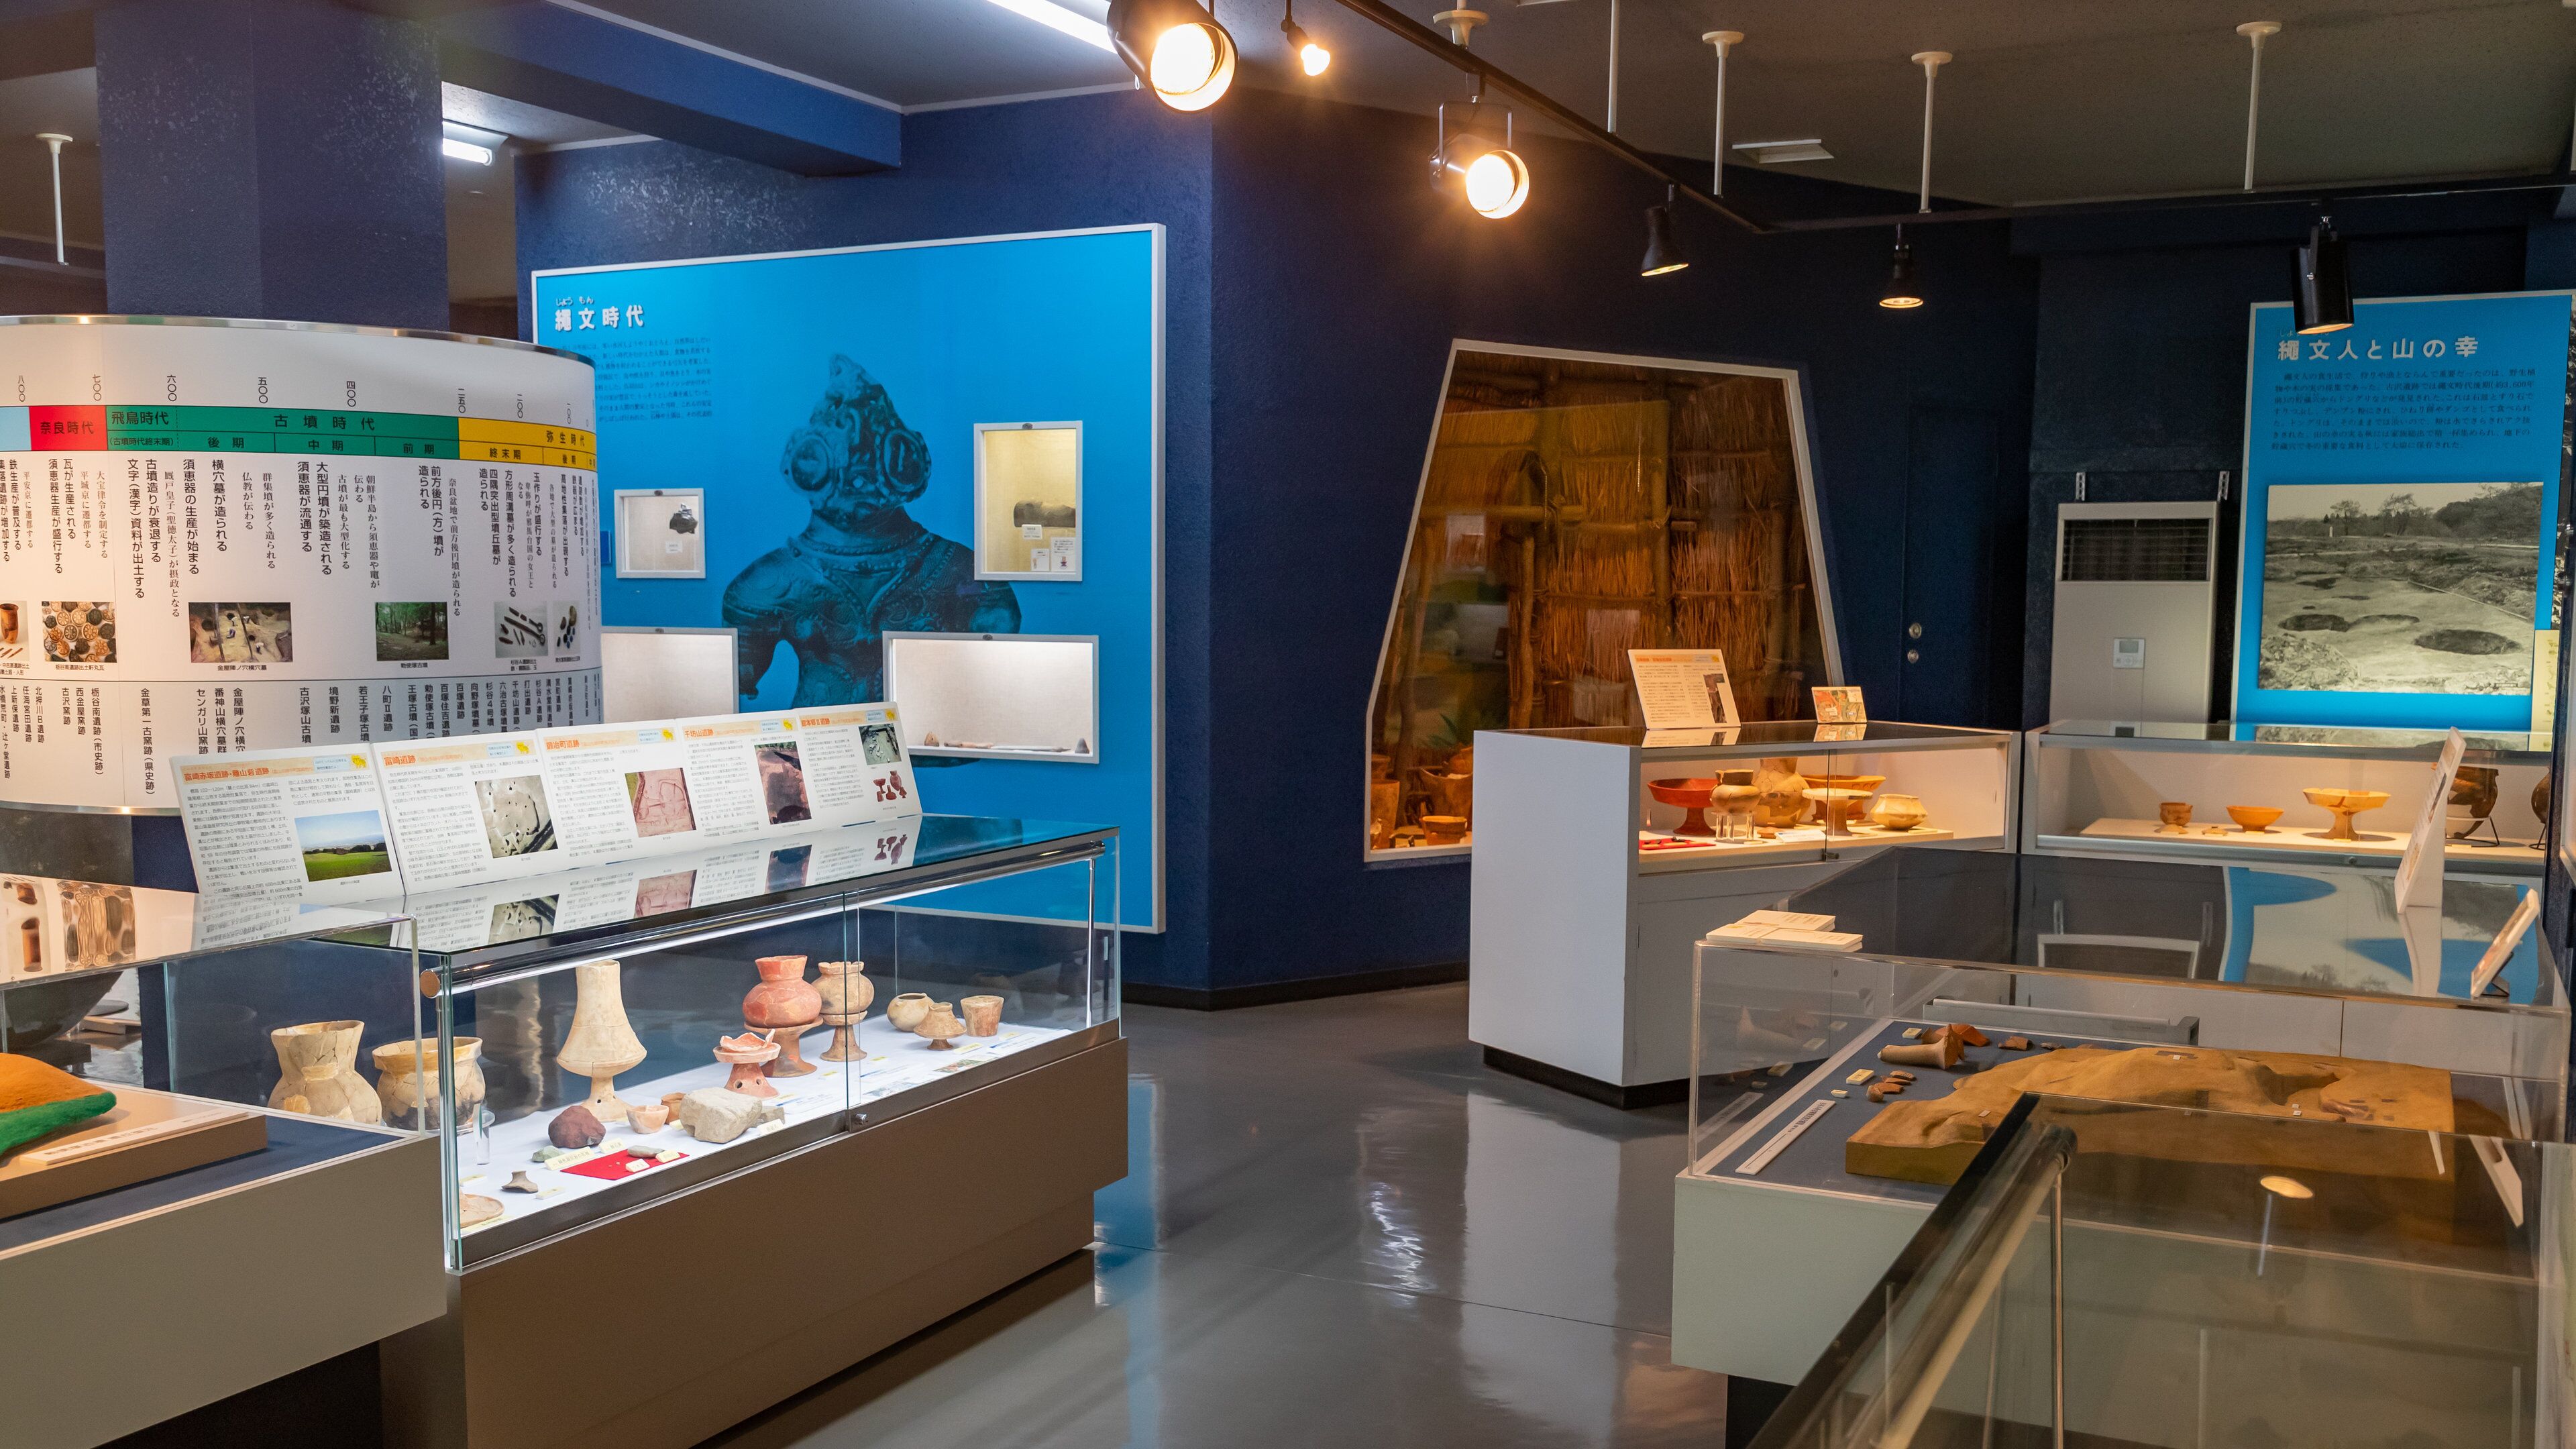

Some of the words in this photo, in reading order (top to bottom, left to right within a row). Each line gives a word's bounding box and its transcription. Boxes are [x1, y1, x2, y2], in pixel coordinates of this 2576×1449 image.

[40, 421, 94, 435] 奈良時代
[109, 437, 174, 446] （古墳時代終末期）
[111, 411, 169, 425] 飛鳥時代
[207, 437, 244, 449] 後期
[274, 415, 375, 431] 古墳時代
[308, 439, 343, 451] 中期
[546, 431, 585, 447] 弥生時代
[403, 443, 435, 455] 前期
[489, 447, 521, 460] 終末期
[562, 453, 577, 466] 後期
[9, 459, 21, 551] 鉄生産が普及する
[23, 471, 34, 548] 平安京に遷都する
[63, 459, 76, 539] 瓦が生産される
[80, 471, 91, 549] 平城京に遷都する
[96, 471, 108, 558] 大宝律令を制定する
[146, 459, 161, 563] 古墳造りが衰退する
[212, 460, 227, 551] 横穴墓が造られる
[242, 472, 254, 530] 仏教が伝わる
[297, 462, 312, 552] 須恵器が流通する
[354, 475, 364, 502] 伝わる
[419, 466, 429, 509] 造られる
[431, 466, 444, 556] 前方後円（方）墳が
[479, 468, 488, 511] 造られる
[517, 482, 523, 499] なる
[533, 472, 542, 556] 玉作りが盛行する
[48, 459, 62, 574] 須恵器生産が盛行する
[127, 459, 145, 598] 文字（漢字）資料が出土する
[183, 459, 199, 575] 須恵器の生産が始まる
[263, 473, 276, 569] 群集墳が多く造られる
[316, 462, 332, 575] 大型円墳が築造される
[337, 474, 350, 570] 古墳が最も大型化する
[490, 470, 501, 566] 四隅突出型墳丘墓が
[504, 470, 517, 597] 方形周溝墓が多く造られる
[448, 478, 461, 616] 奈良盆地で前方後円墳が造られる
[62, 688, 70, 725] 古沢窯跡
[76, 688, 86, 735] 西金屋窯跡
[197, 689, 209, 755] センガリ山窯跡
[215, 688, 227, 753] 番神山横穴墓群
[299, 687, 311, 744] 古沢塚山古墳
[329, 687, 340, 733] 境野新遺跡
[358, 686, 370, 742] 若王子塚古墳
[408, 684, 419, 740] 王塚古墳（国
[425, 684, 435, 739] 勅使塚古墳（
[456, 683, 465, 720] 百塚遺跡
[91, 688, 104, 775] 栃谷南遺跡（市史跡）
[141, 688, 155, 795] 金草第一古窯跡（県史跡）
[546, 740, 579, 750] 鍛冶町遺跡
[684, 729, 714, 738] 千坊山遺跡
[384, 755, 416, 766] 富崎遺跡
